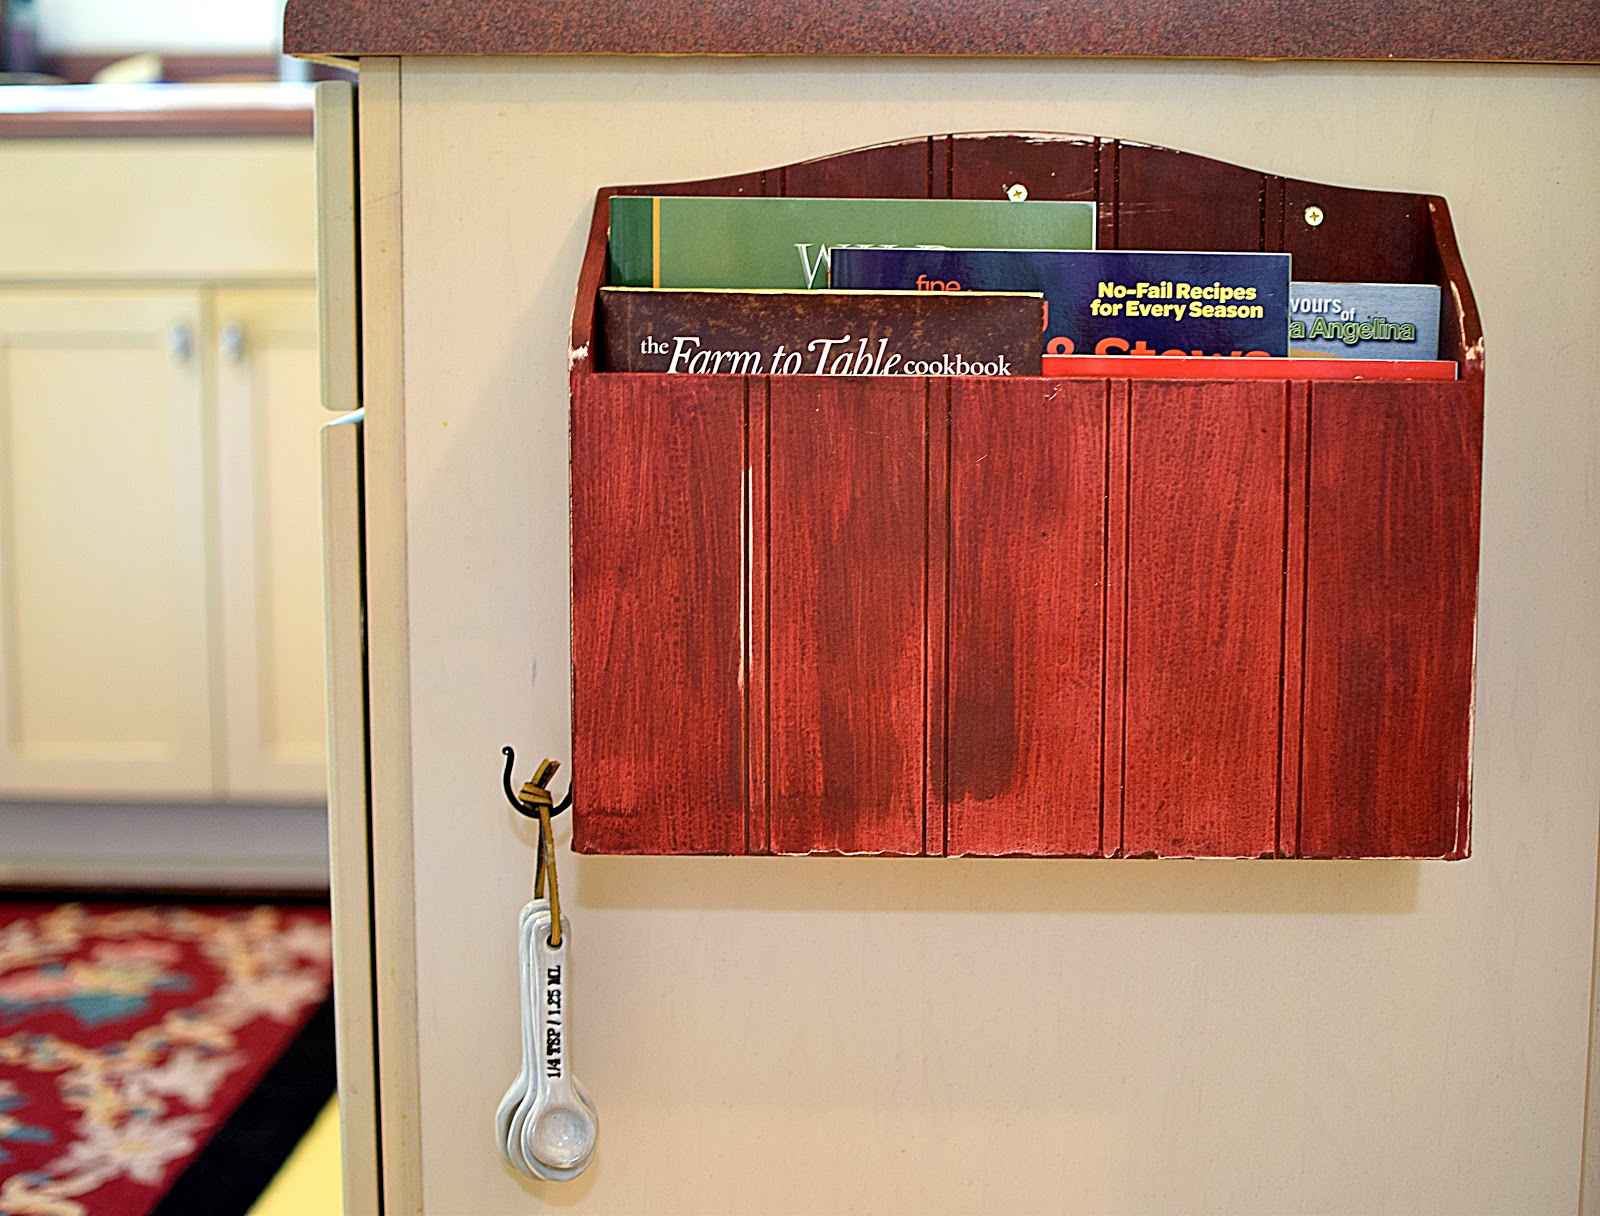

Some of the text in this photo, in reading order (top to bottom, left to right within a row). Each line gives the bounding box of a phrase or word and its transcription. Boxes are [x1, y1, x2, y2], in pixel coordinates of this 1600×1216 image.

[916, 273, 961, 291] fine
[1097, 281, 1257, 303] No-Fail Recipes
[1090, 299, 1264, 321] for Every Season
[1340, 307, 1356, 321] of
[1309, 316, 1416, 344] Angelina
[640, 334, 1012, 376] the Farm to Table cookbook
[547, 965, 561, 986] ML
[547, 1028, 561, 1056] TSP
[547, 1059, 561, 1078] 1/4
